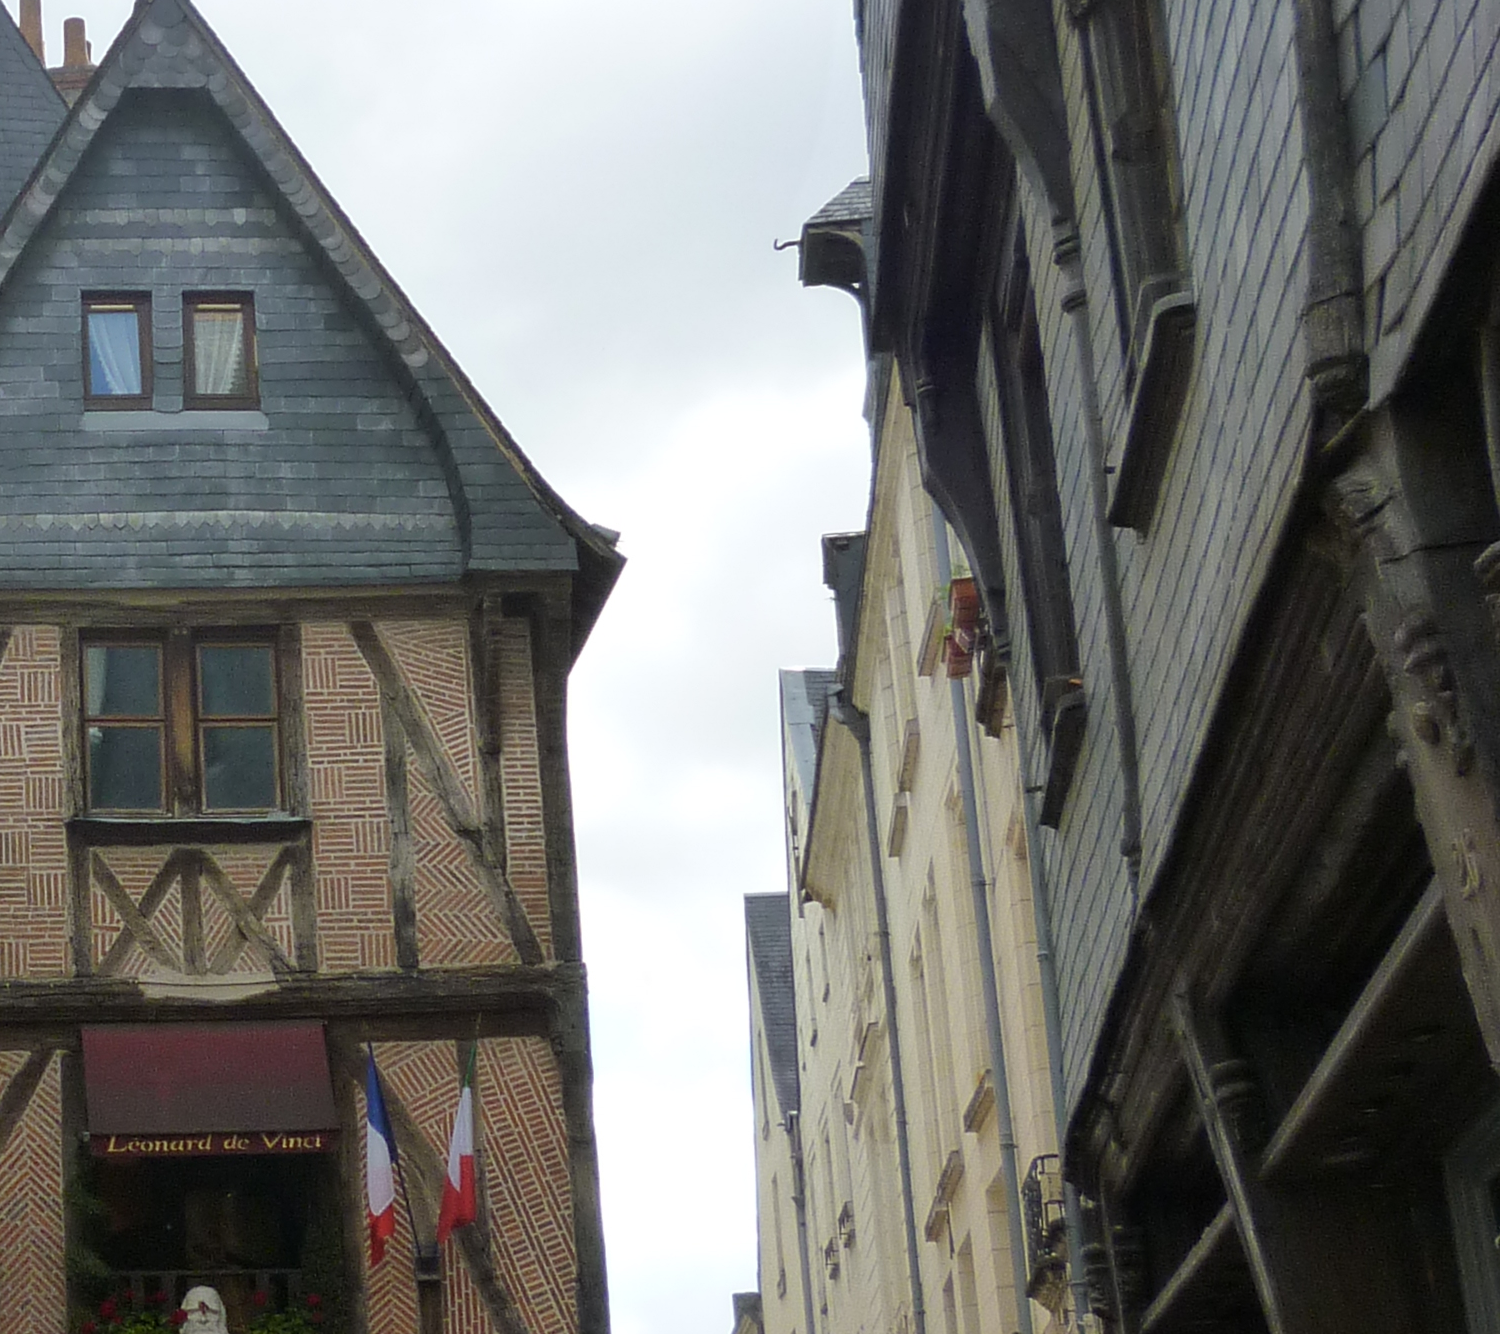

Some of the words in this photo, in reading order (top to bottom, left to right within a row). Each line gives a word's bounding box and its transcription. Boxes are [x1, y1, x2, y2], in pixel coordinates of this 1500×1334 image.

[107, 1133, 213, 1154] Léonard
[223, 1133, 250, 1151] de
[261, 1132, 322, 1150] Vinci
